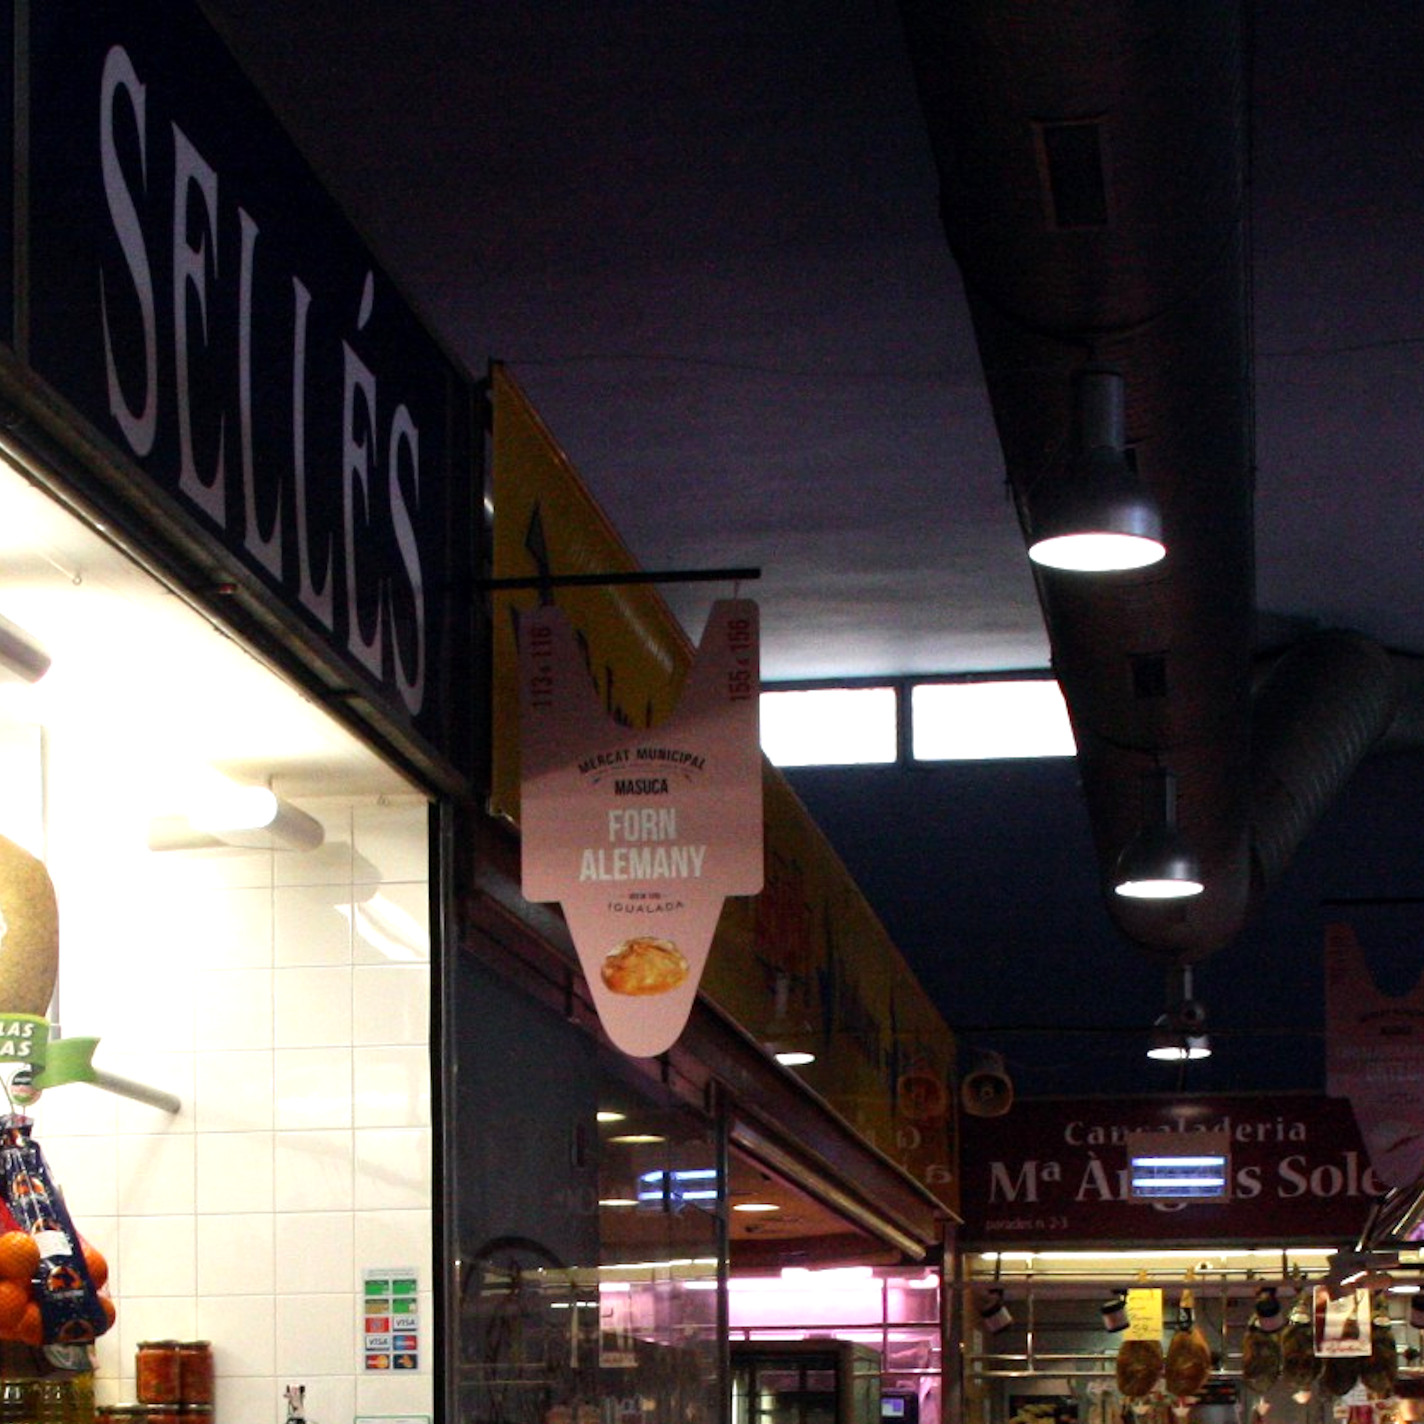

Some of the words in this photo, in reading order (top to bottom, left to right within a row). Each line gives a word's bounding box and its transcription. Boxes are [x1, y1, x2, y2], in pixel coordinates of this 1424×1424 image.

[99, 45, 425, 717] SELLÉS
[578, 749, 631, 774] MERCAT
[635, 748, 706, 771] MUNICIPAL
[613, 777, 669, 796] MASUCA
[608, 807, 676, 843] FORN
[578, 844, 707, 883] ALEMANY
[607, 900, 685, 914] IGUALADA
[1064, 1116, 1308, 1146] Canlderia
